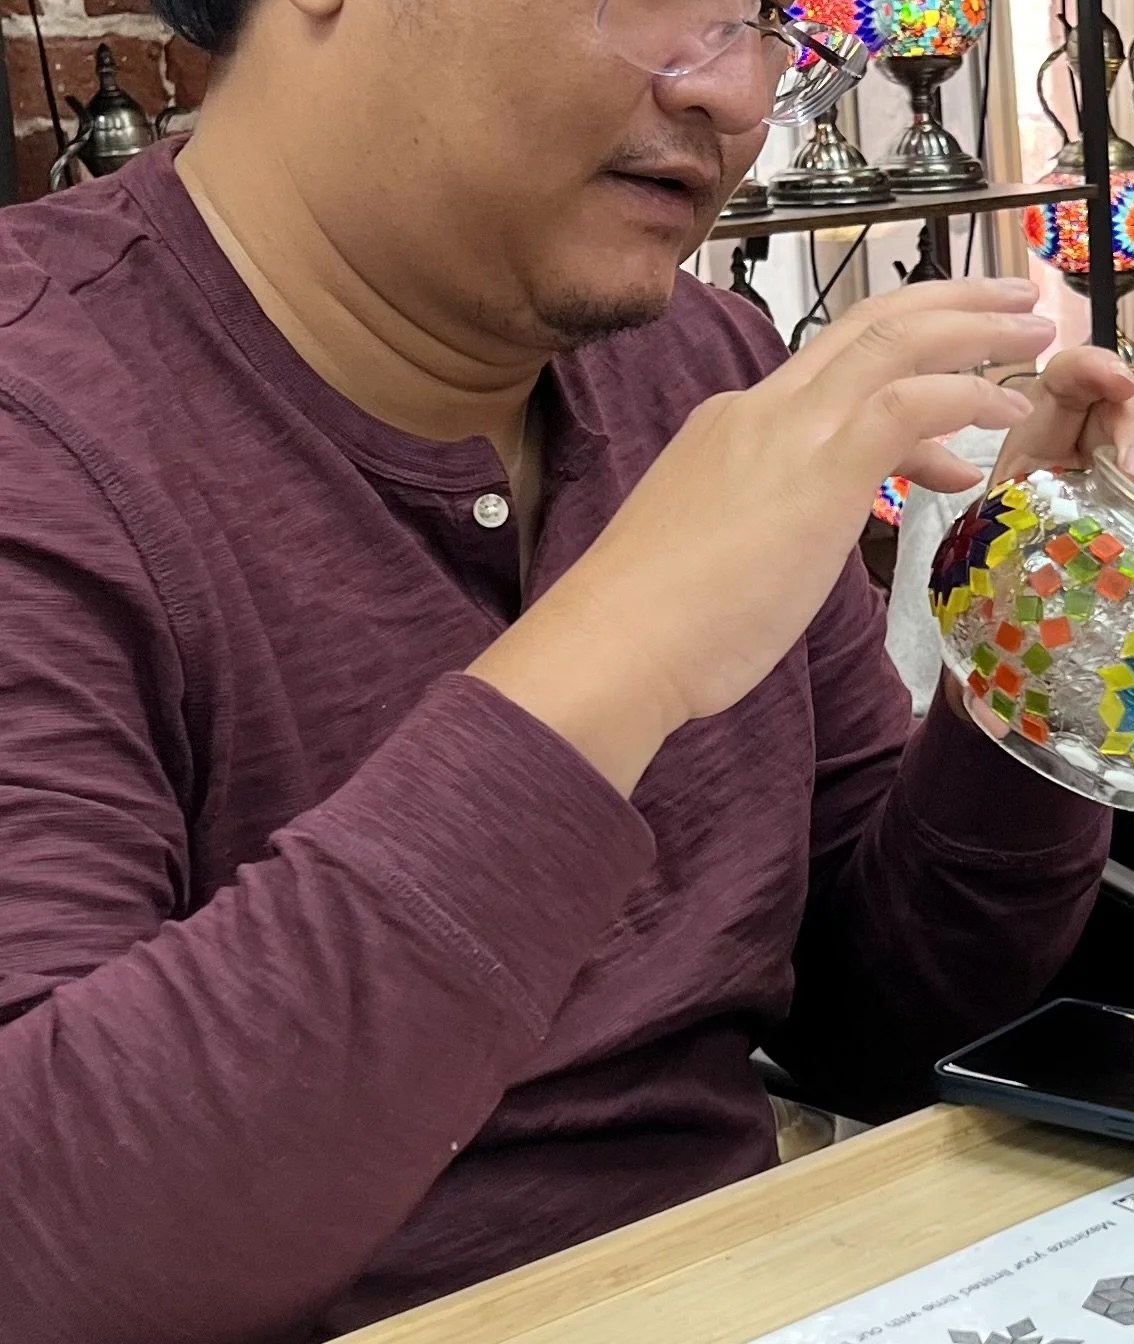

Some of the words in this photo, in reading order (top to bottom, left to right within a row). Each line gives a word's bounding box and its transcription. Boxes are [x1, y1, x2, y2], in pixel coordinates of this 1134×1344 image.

[1046, 1219, 1118, 1253] Maximize
[1013, 1249, 1048, 1271] your
[958, 1268, 1014, 1297] limited
[920, 1293, 960, 1312] time
[884, 1310, 919, 1328] with
[857, 1326, 884, 1343] our
